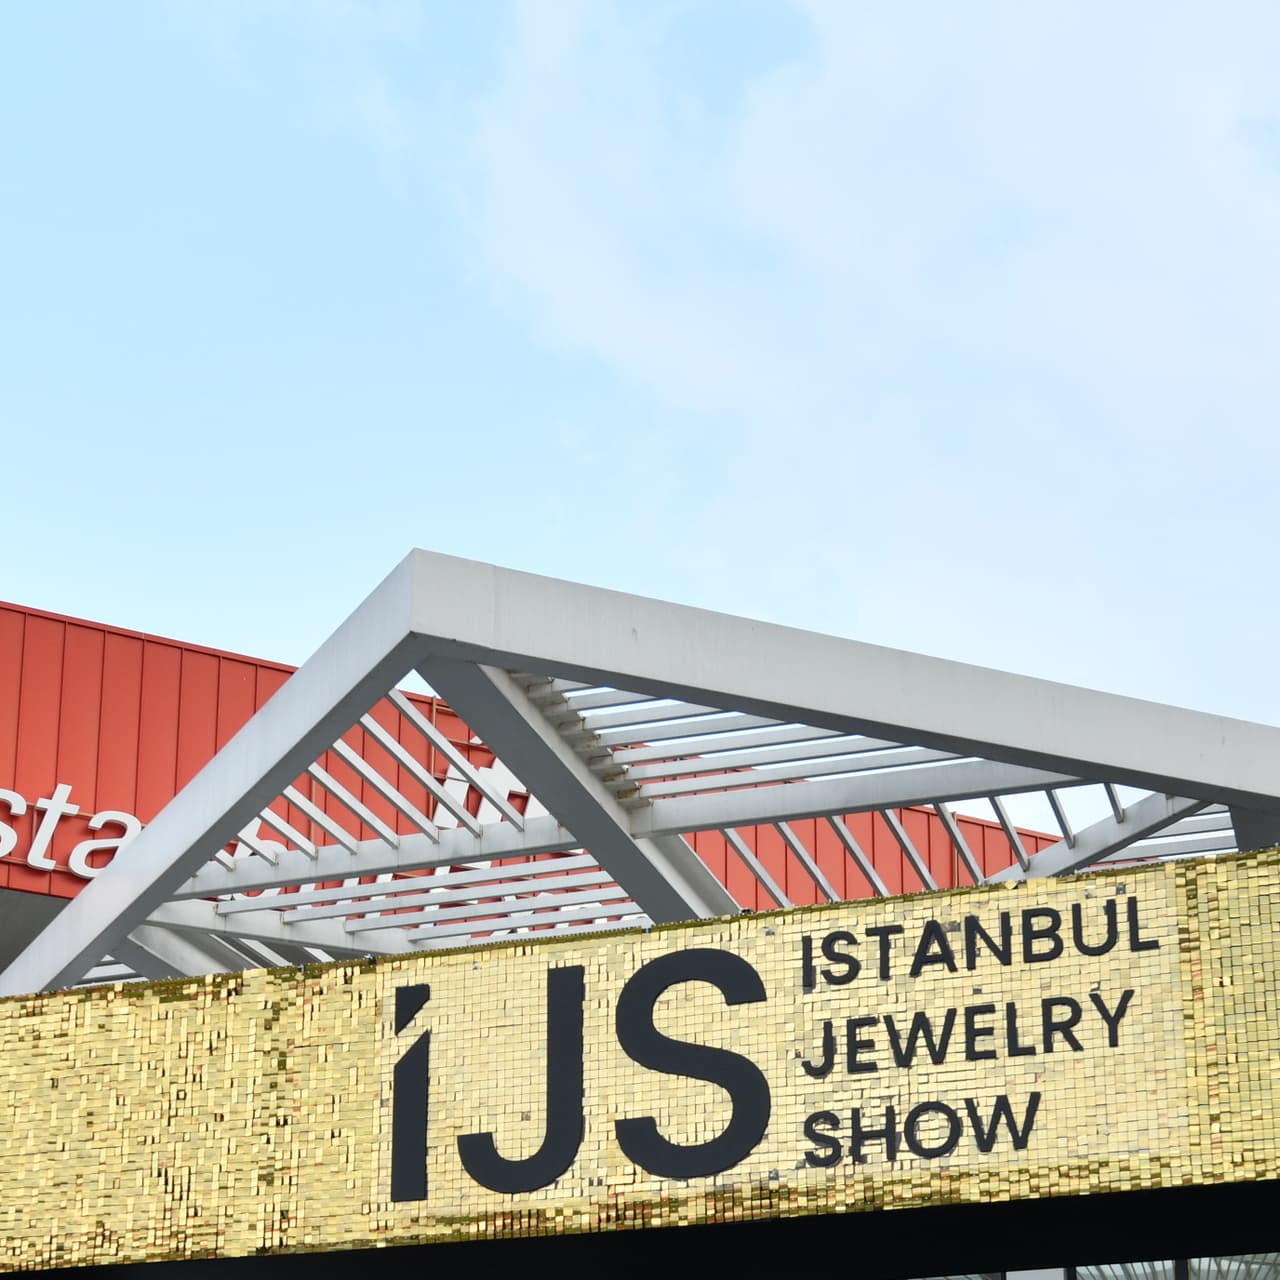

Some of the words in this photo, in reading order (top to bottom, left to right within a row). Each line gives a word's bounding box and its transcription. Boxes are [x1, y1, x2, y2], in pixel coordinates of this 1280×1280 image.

[801, 896, 1161, 993] ISTANBUL
[801, 988, 1135, 1079] JEWELRY
[803, 1091, 1042, 1168] SHOW
